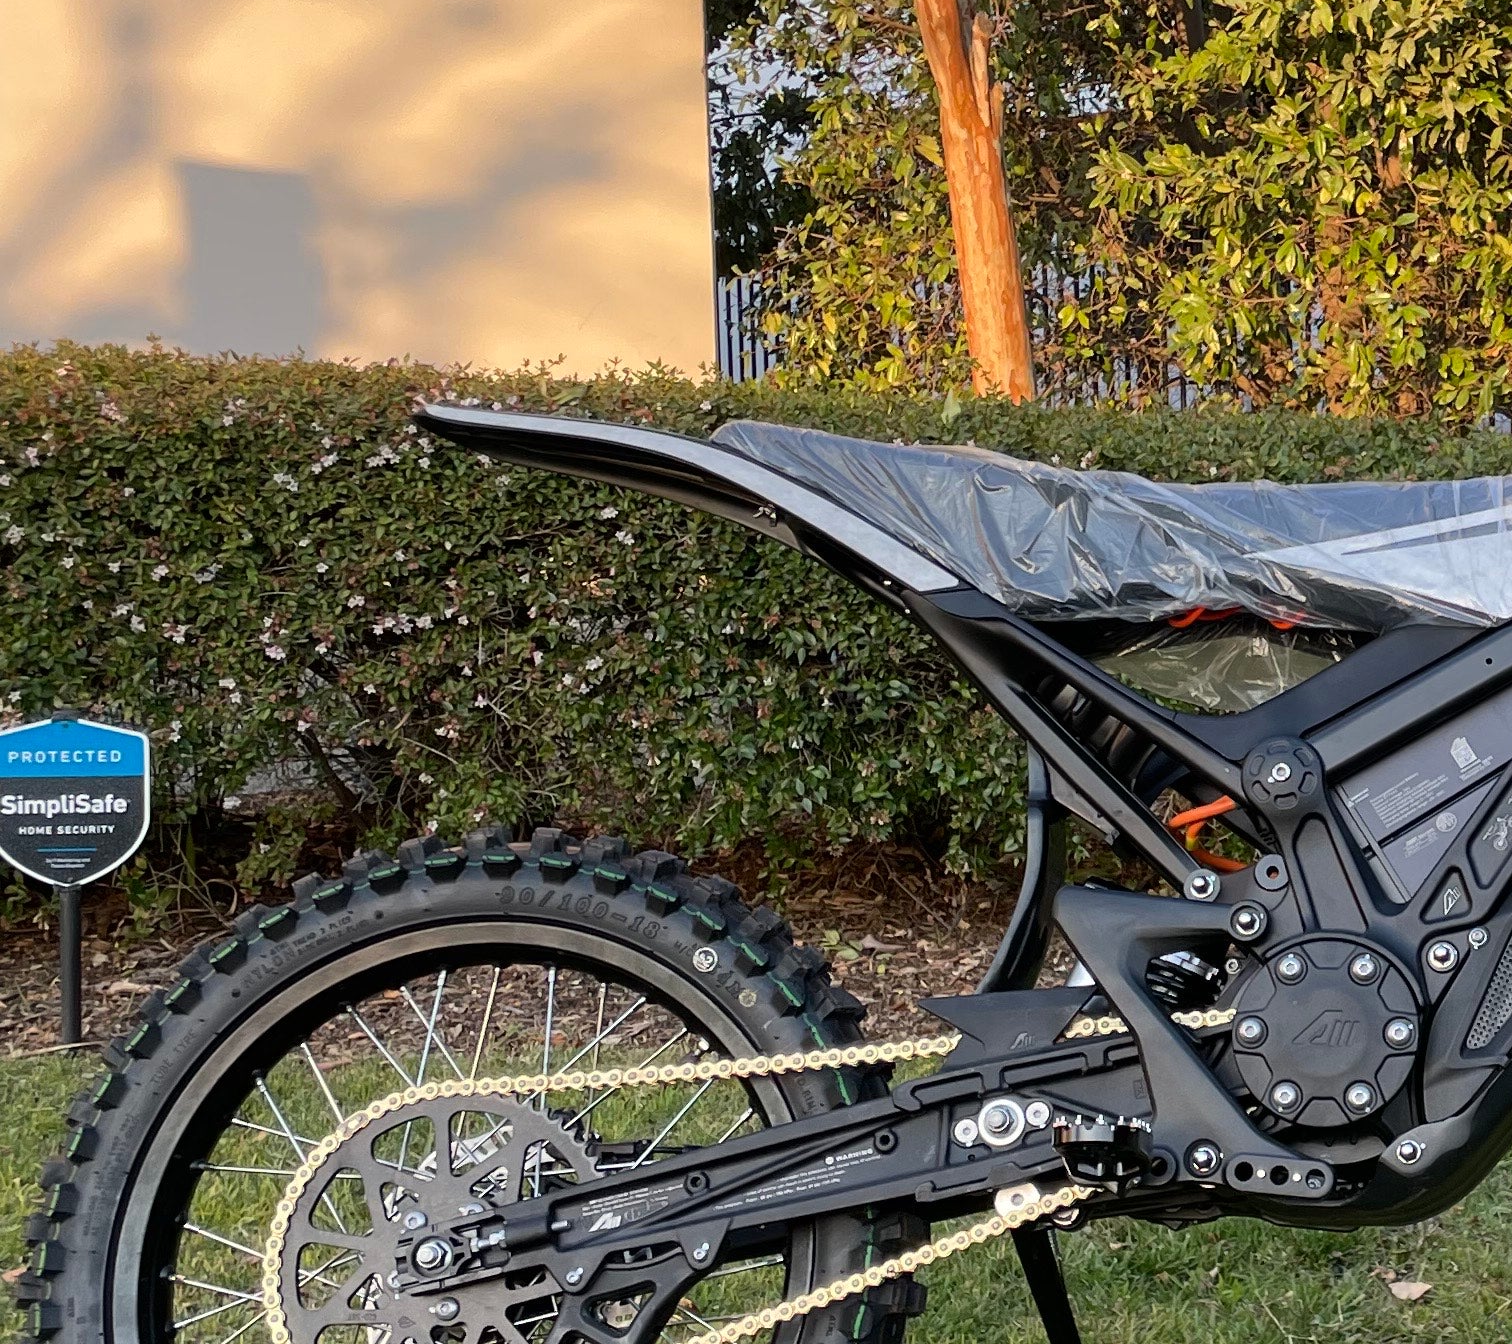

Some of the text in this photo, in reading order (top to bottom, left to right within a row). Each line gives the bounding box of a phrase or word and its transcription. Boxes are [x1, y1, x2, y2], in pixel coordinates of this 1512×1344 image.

[7, 749, 123, 764] PROTECTED
[0, 793, 129, 819] SimpliSafe
[18, 824, 116, 836] HOME SECURITY
[498, 884, 662, 941] 90/100-18
[835, 1148, 874, 1162] WARNING
